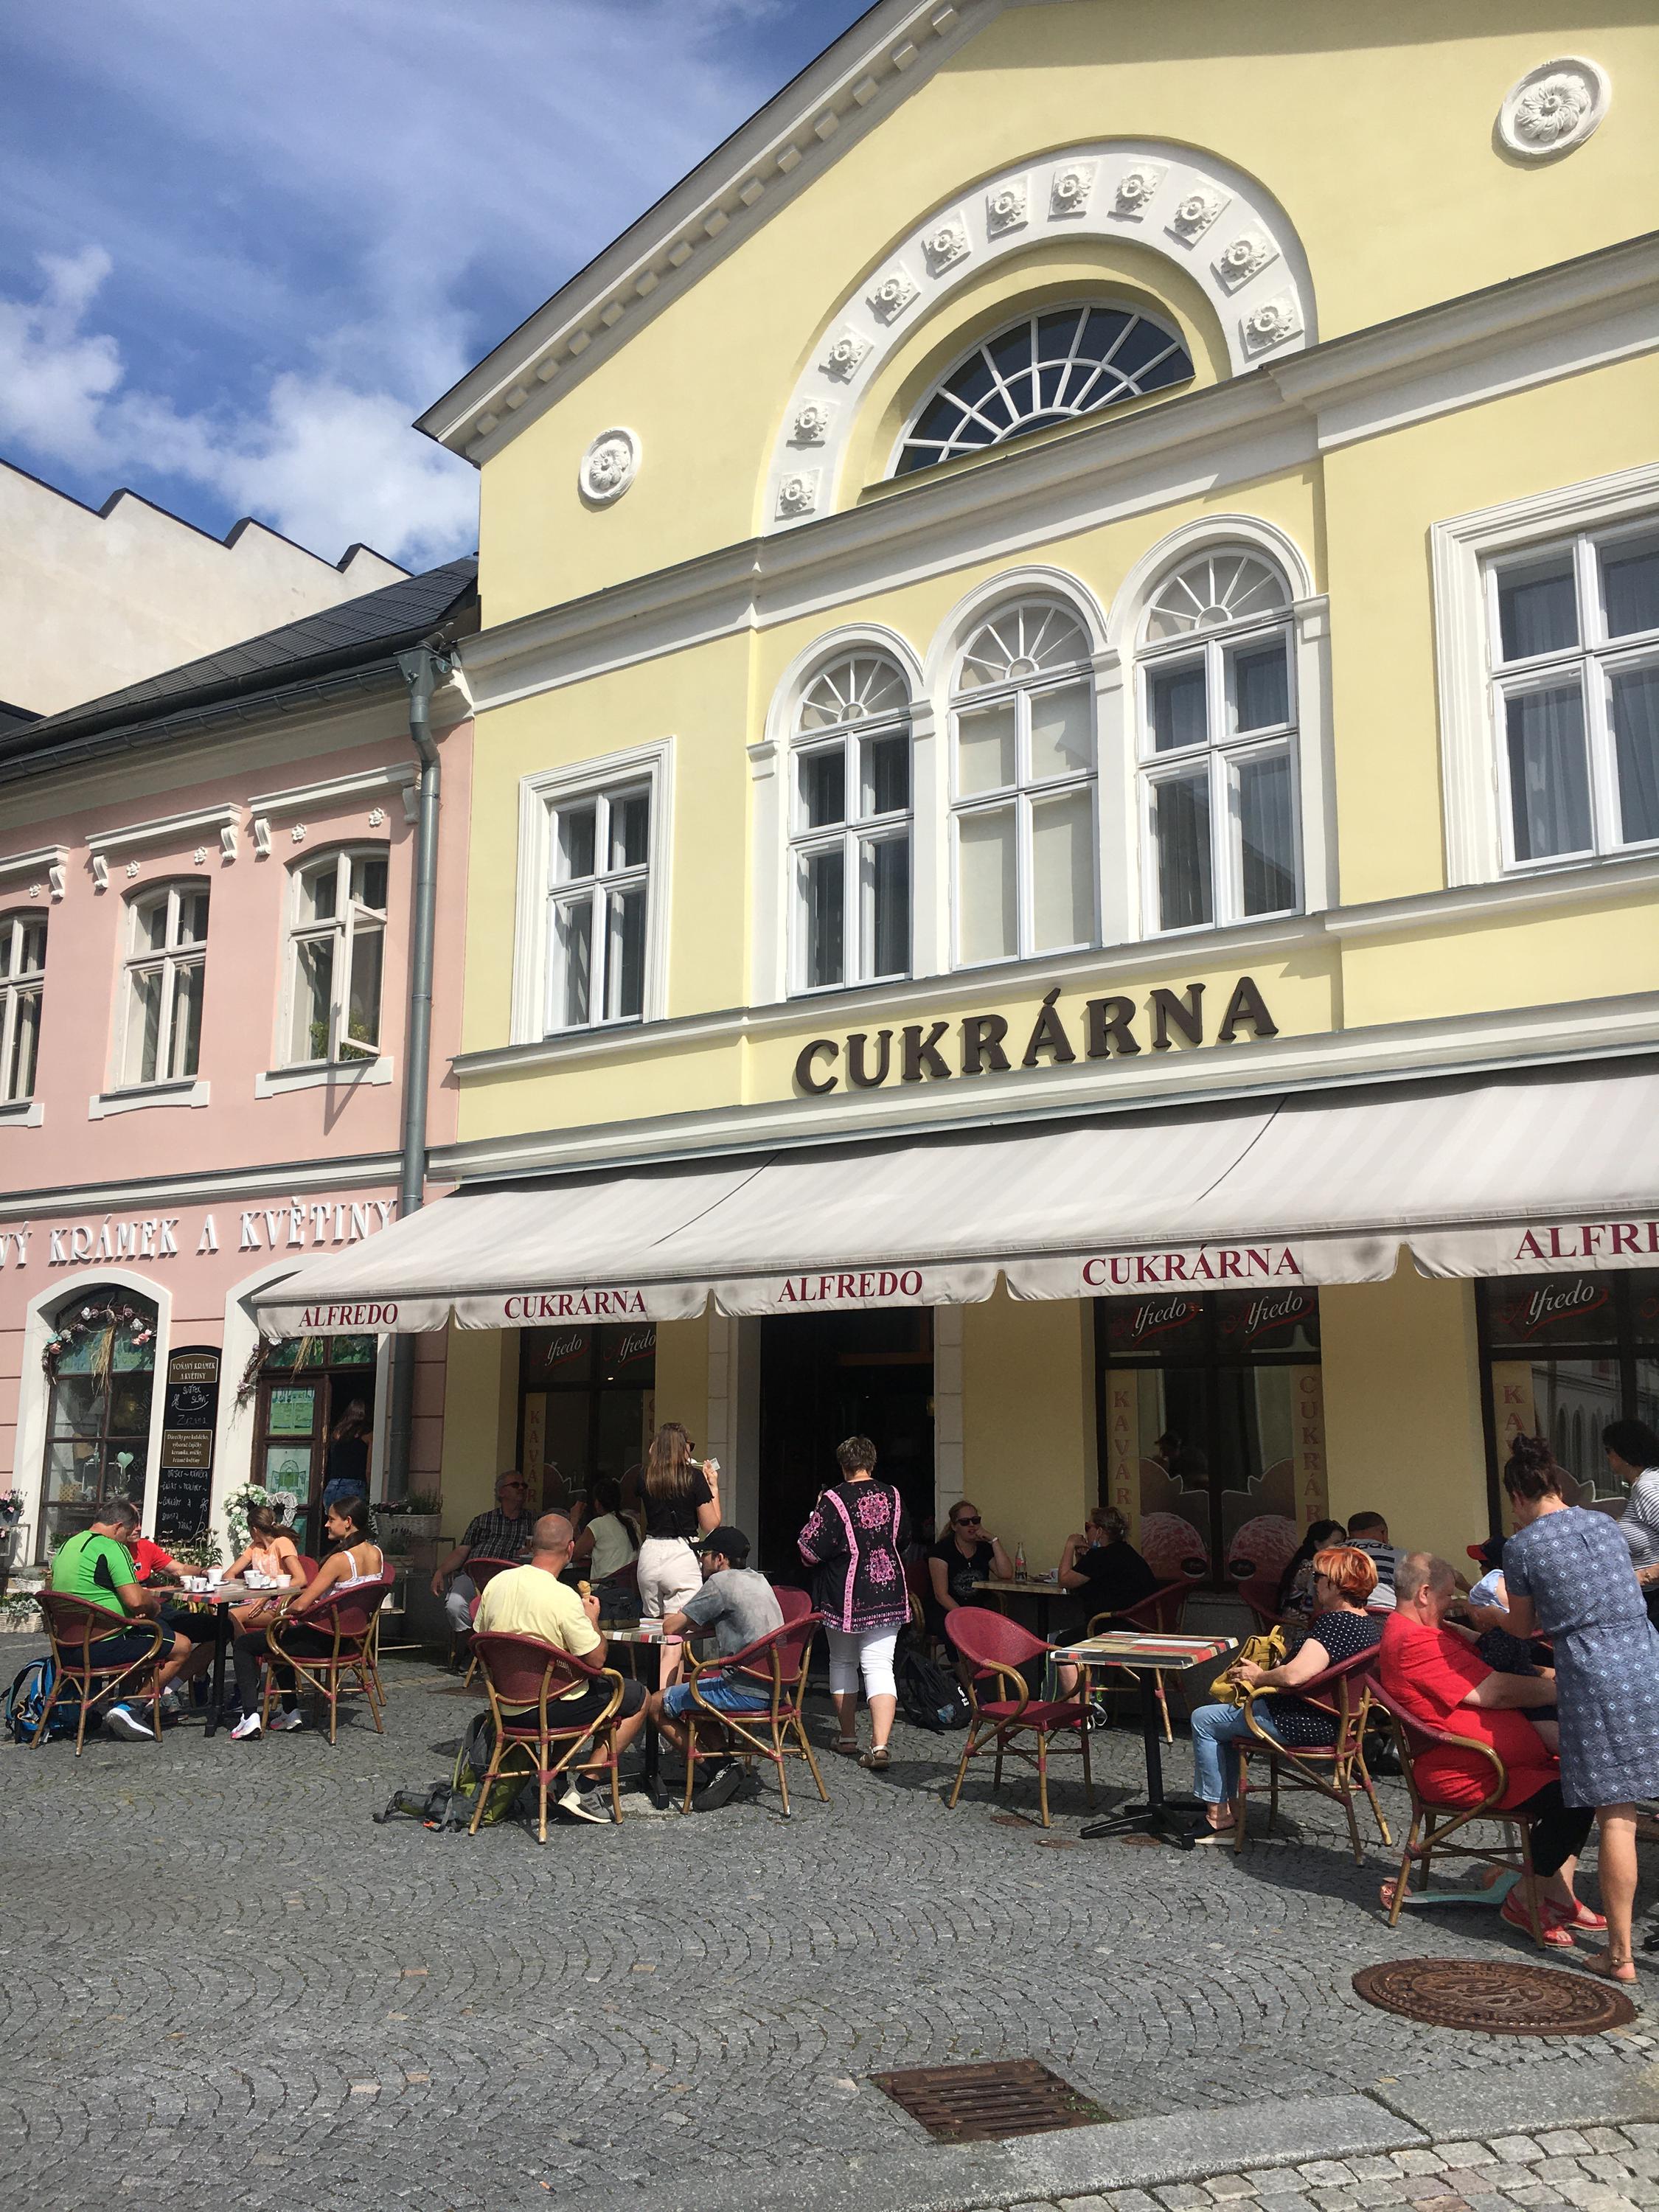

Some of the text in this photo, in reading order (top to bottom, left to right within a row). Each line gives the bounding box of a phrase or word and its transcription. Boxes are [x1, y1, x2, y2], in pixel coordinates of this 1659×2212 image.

[795, 976, 1279, 1093] CUKRÁRNA
[49, 1214, 179, 1263] KRÁMEK
[197, 1214, 219, 1251] A
[239, 1196, 397, 1248] KVĚTINY
[777, 1270, 923, 1303] ALFREDO
[1082, 1243, 1302, 1286] CUKRÁRNA
[299, 1304, 398, 1327] ALFREDO
[504, 1287, 647, 1320] CUKRÁRNA
[194, 1361, 216, 1369] KRÁMEK
[527, 1410, 541, 1504] KAVÁR
[1113, 1390, 1133, 1529] KAVÁR
[1299, 1375, 1322, 1523] CUKRÁR
